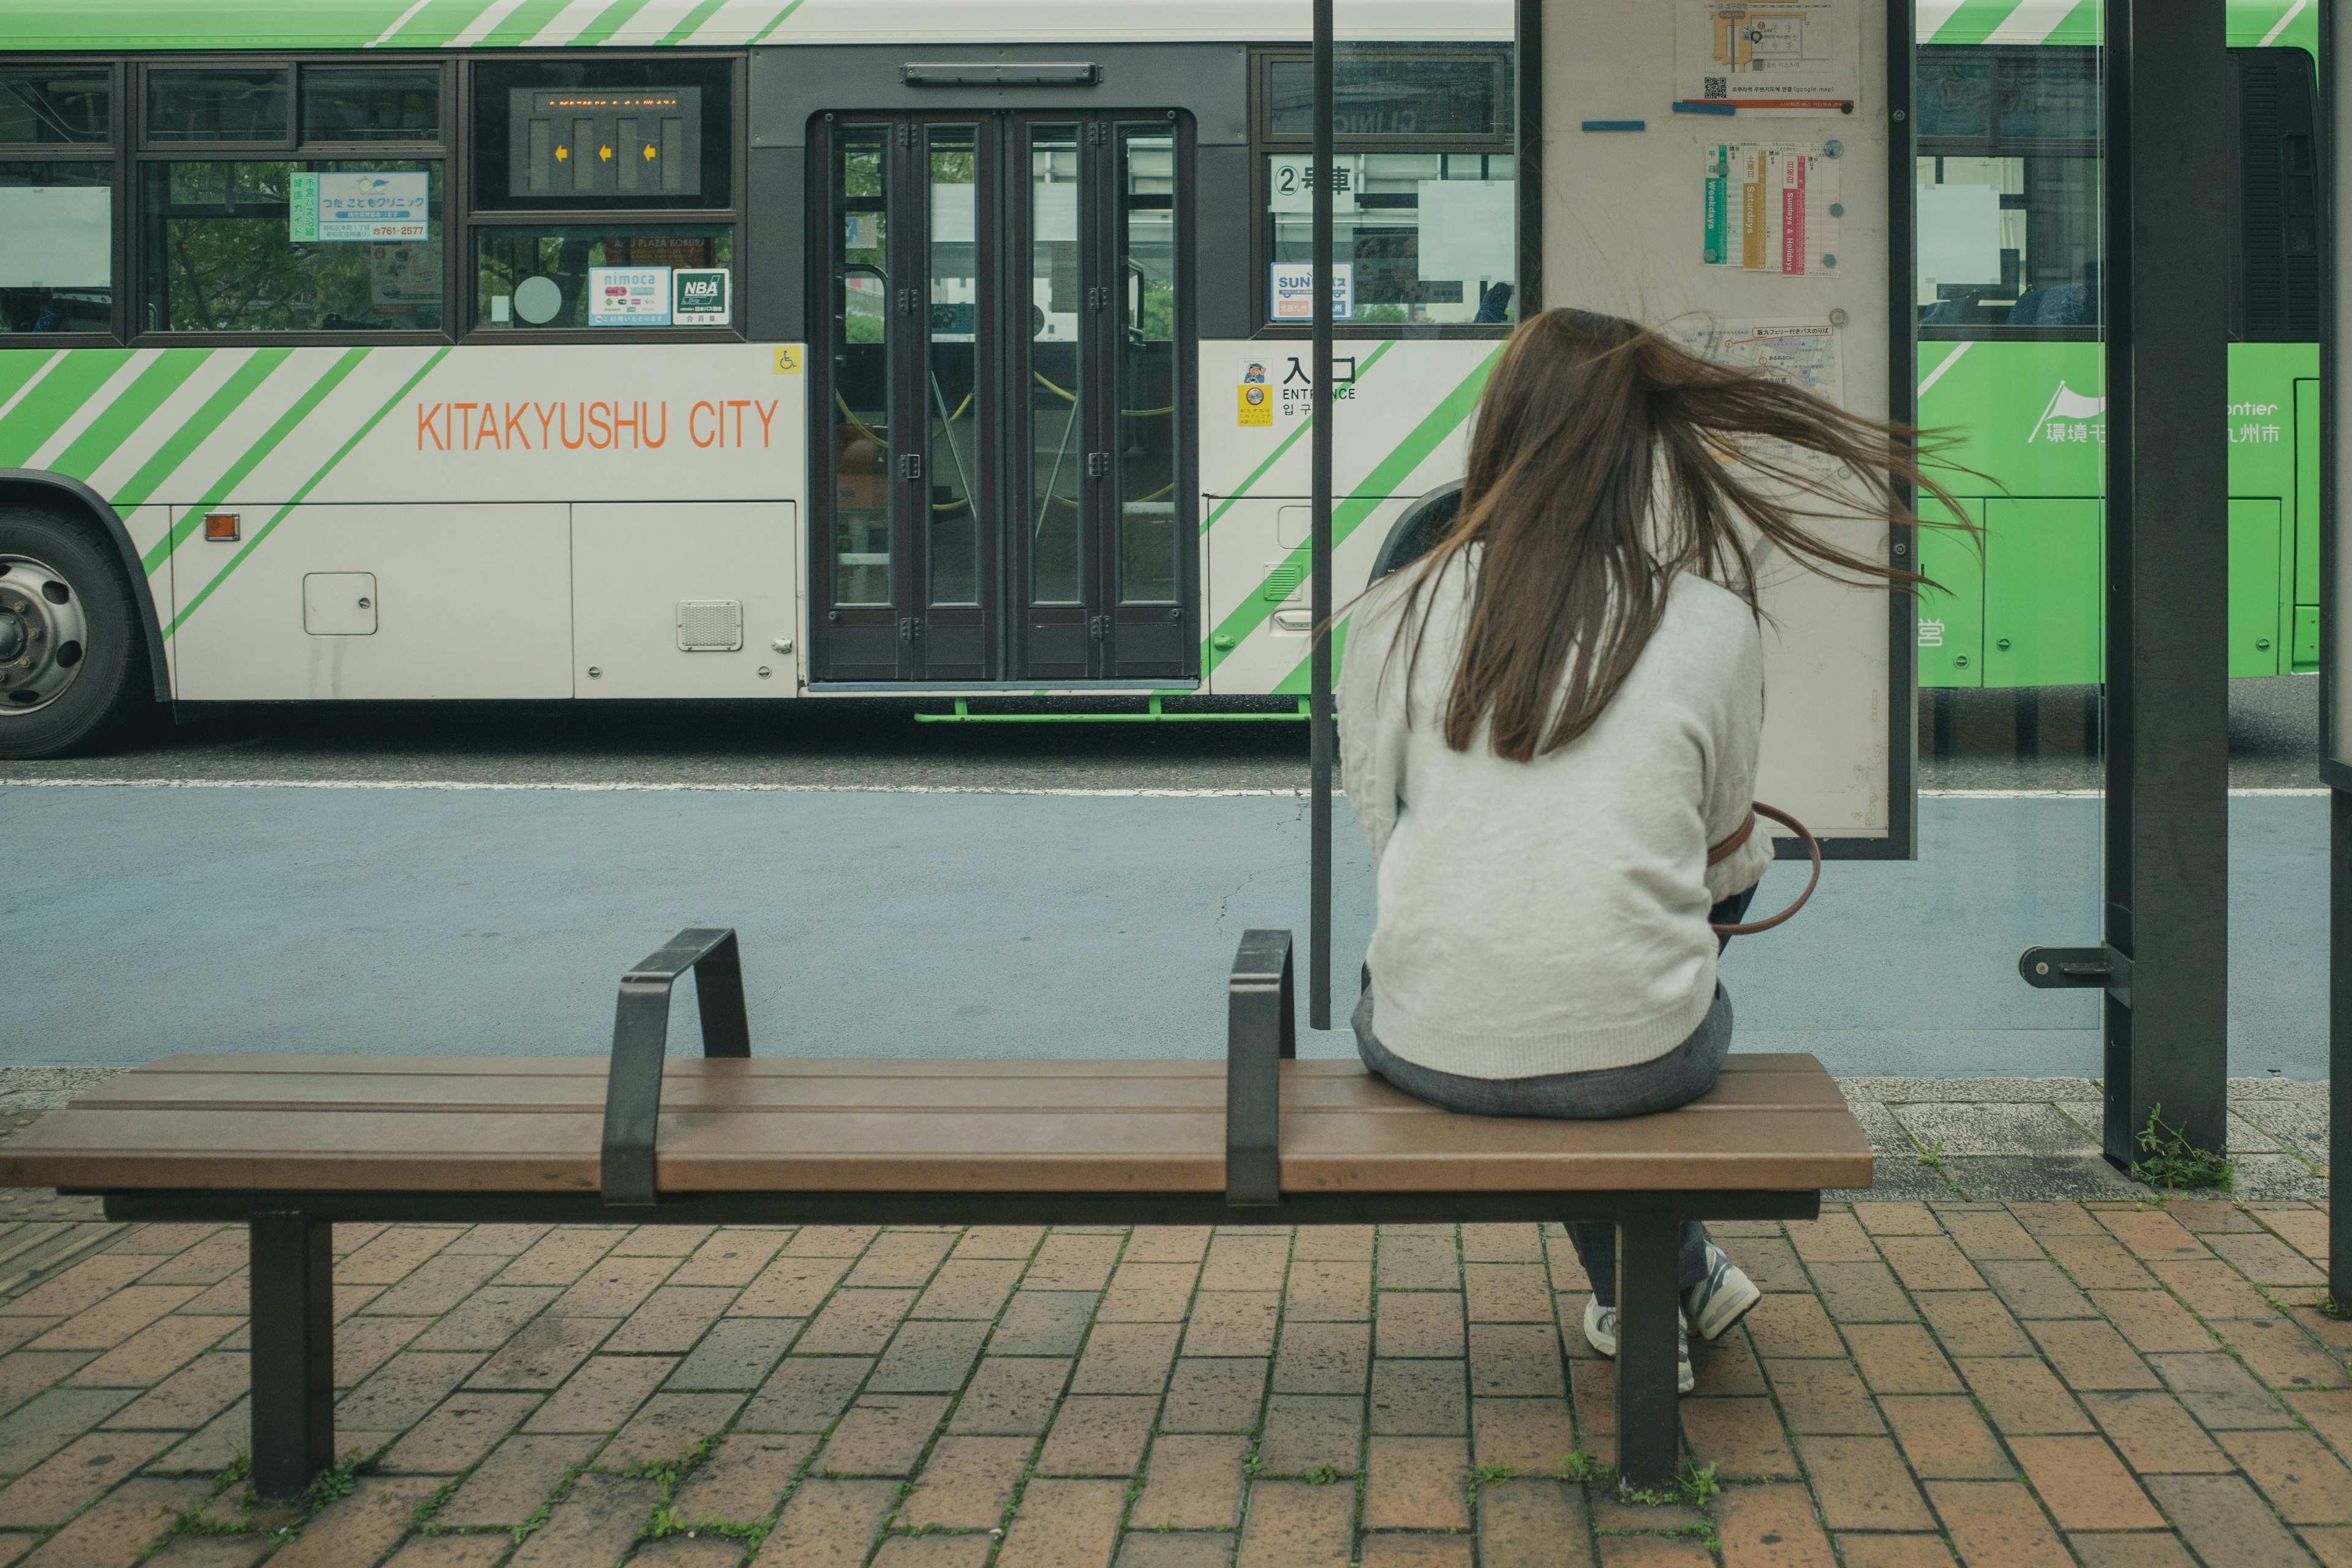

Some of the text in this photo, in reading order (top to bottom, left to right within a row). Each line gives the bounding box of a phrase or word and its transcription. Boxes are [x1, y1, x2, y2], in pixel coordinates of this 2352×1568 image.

[1708, 150, 1716, 173] 平日
[293, 178, 303, 236] 健康ガイド
[305, 178, 315, 237] 市営バス沿線
[1707, 181, 1716, 230] Weekdays
[1746, 186, 1755, 234] Saturdays
[604, 272, 655, 285] nimoca
[685, 282, 718, 294] NBA
[1279, 276, 1346, 288] SUNス
[1283, 356, 1355, 384] 入口
[1283, 388, 1355, 399] ENTNCE
[418, 400, 779, 451] KITAKYUSHU CITY
